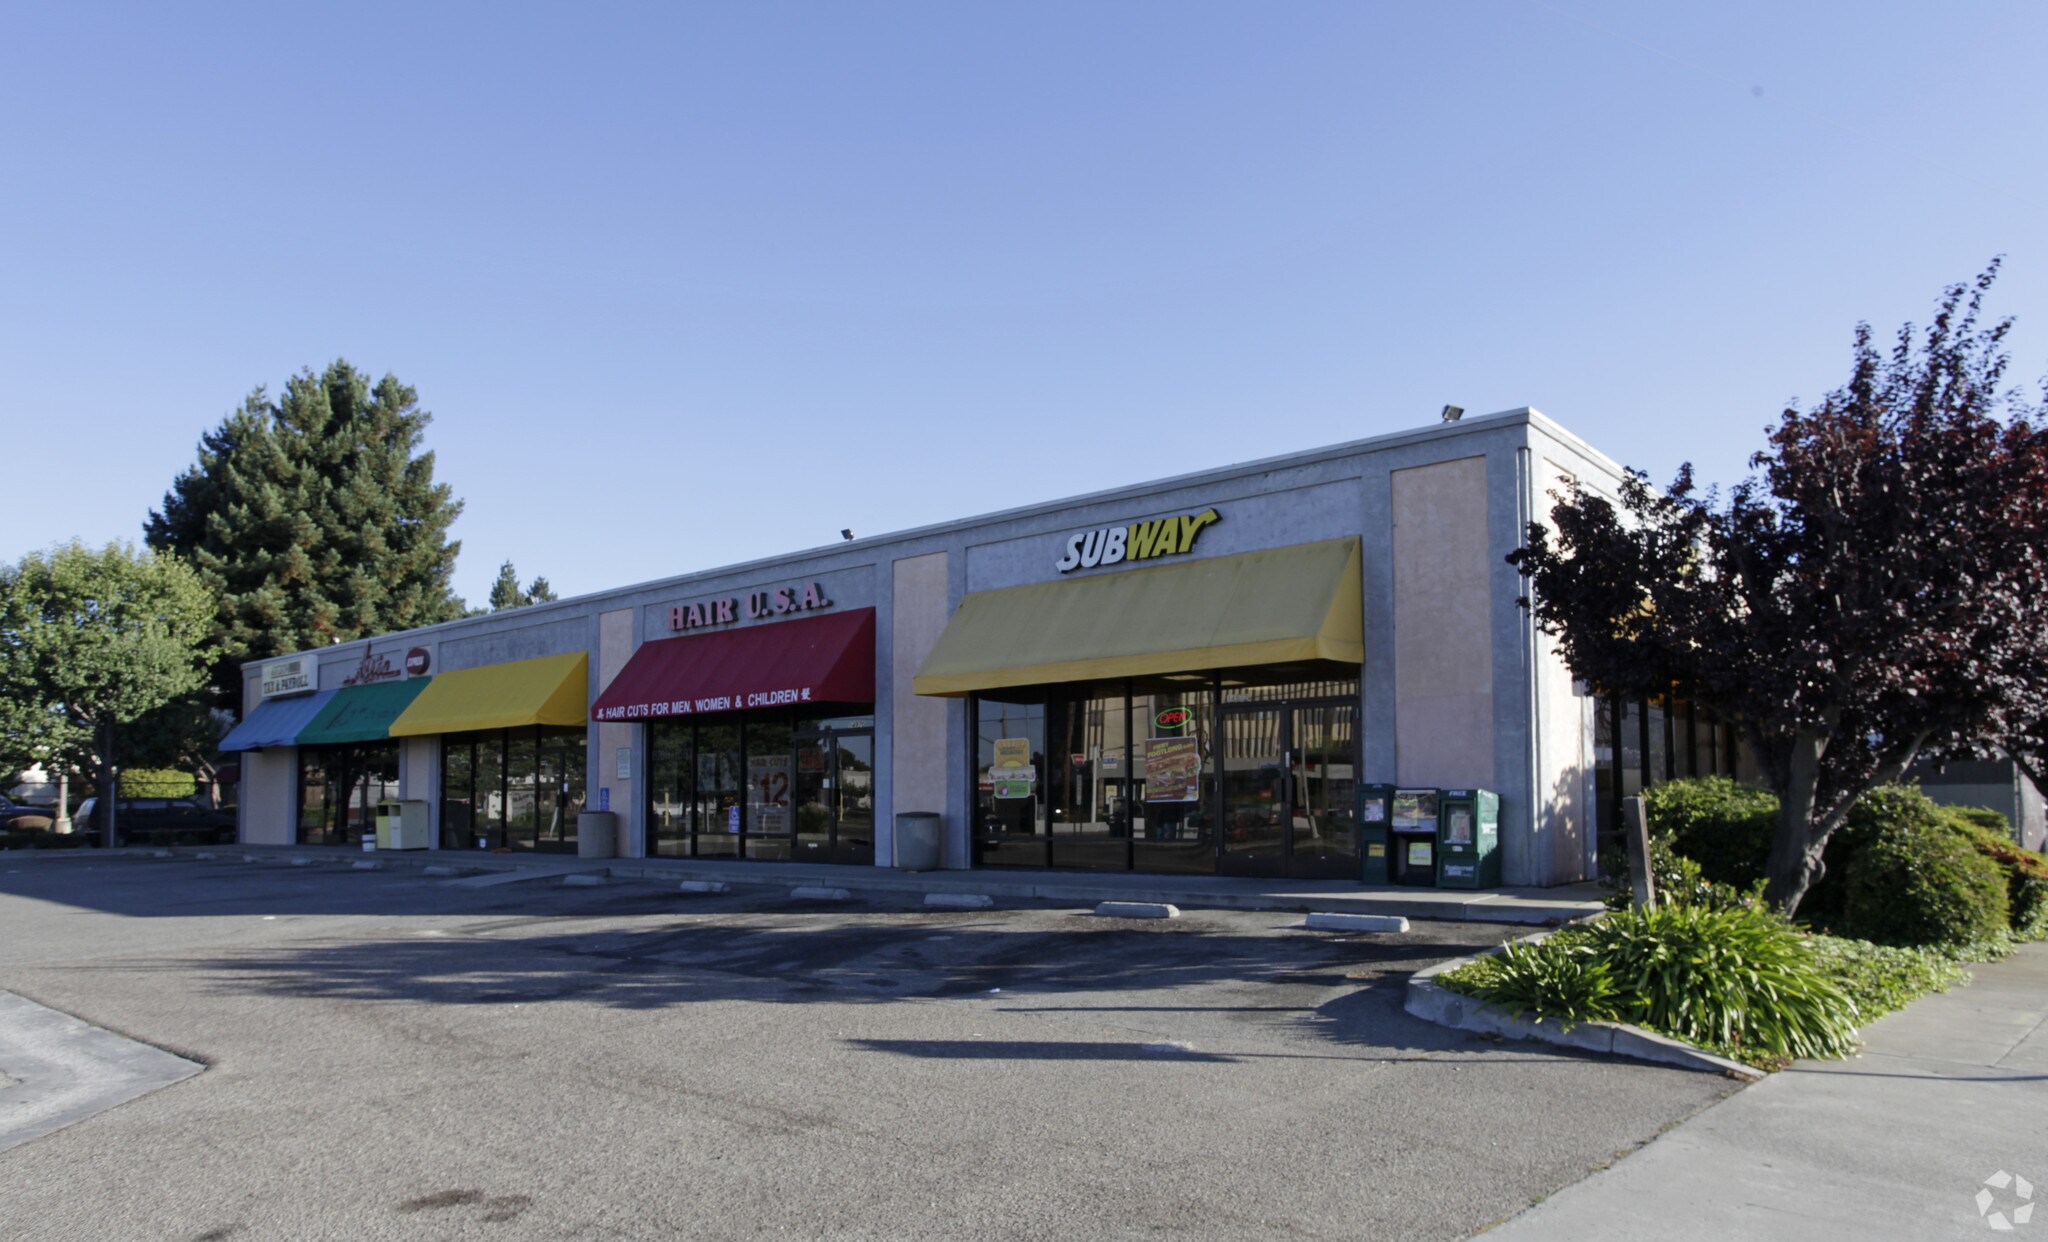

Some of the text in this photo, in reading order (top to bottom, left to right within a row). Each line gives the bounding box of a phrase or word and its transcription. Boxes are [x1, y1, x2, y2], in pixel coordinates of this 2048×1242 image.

[1055, 508, 1220, 573] SUBWAY
[668, 582, 831, 630] HAIR U.S.A.
[264, 681, 275, 694] TAX
[281, 675, 309, 690] PAYROLL
[606, 705, 625, 718] HAIR
[627, 704, 648, 717] CUTS
[651, 702, 669, 715] FOR
[695, 696, 731, 711] WOMEN
[735, 695, 742, 708] &
[748, 689, 799, 707] CHILDREN
[1159, 711, 1187, 724] OPEN
[1147, 744, 1183, 759] FOOTLONG
[770, 757, 789, 768] CUTS
